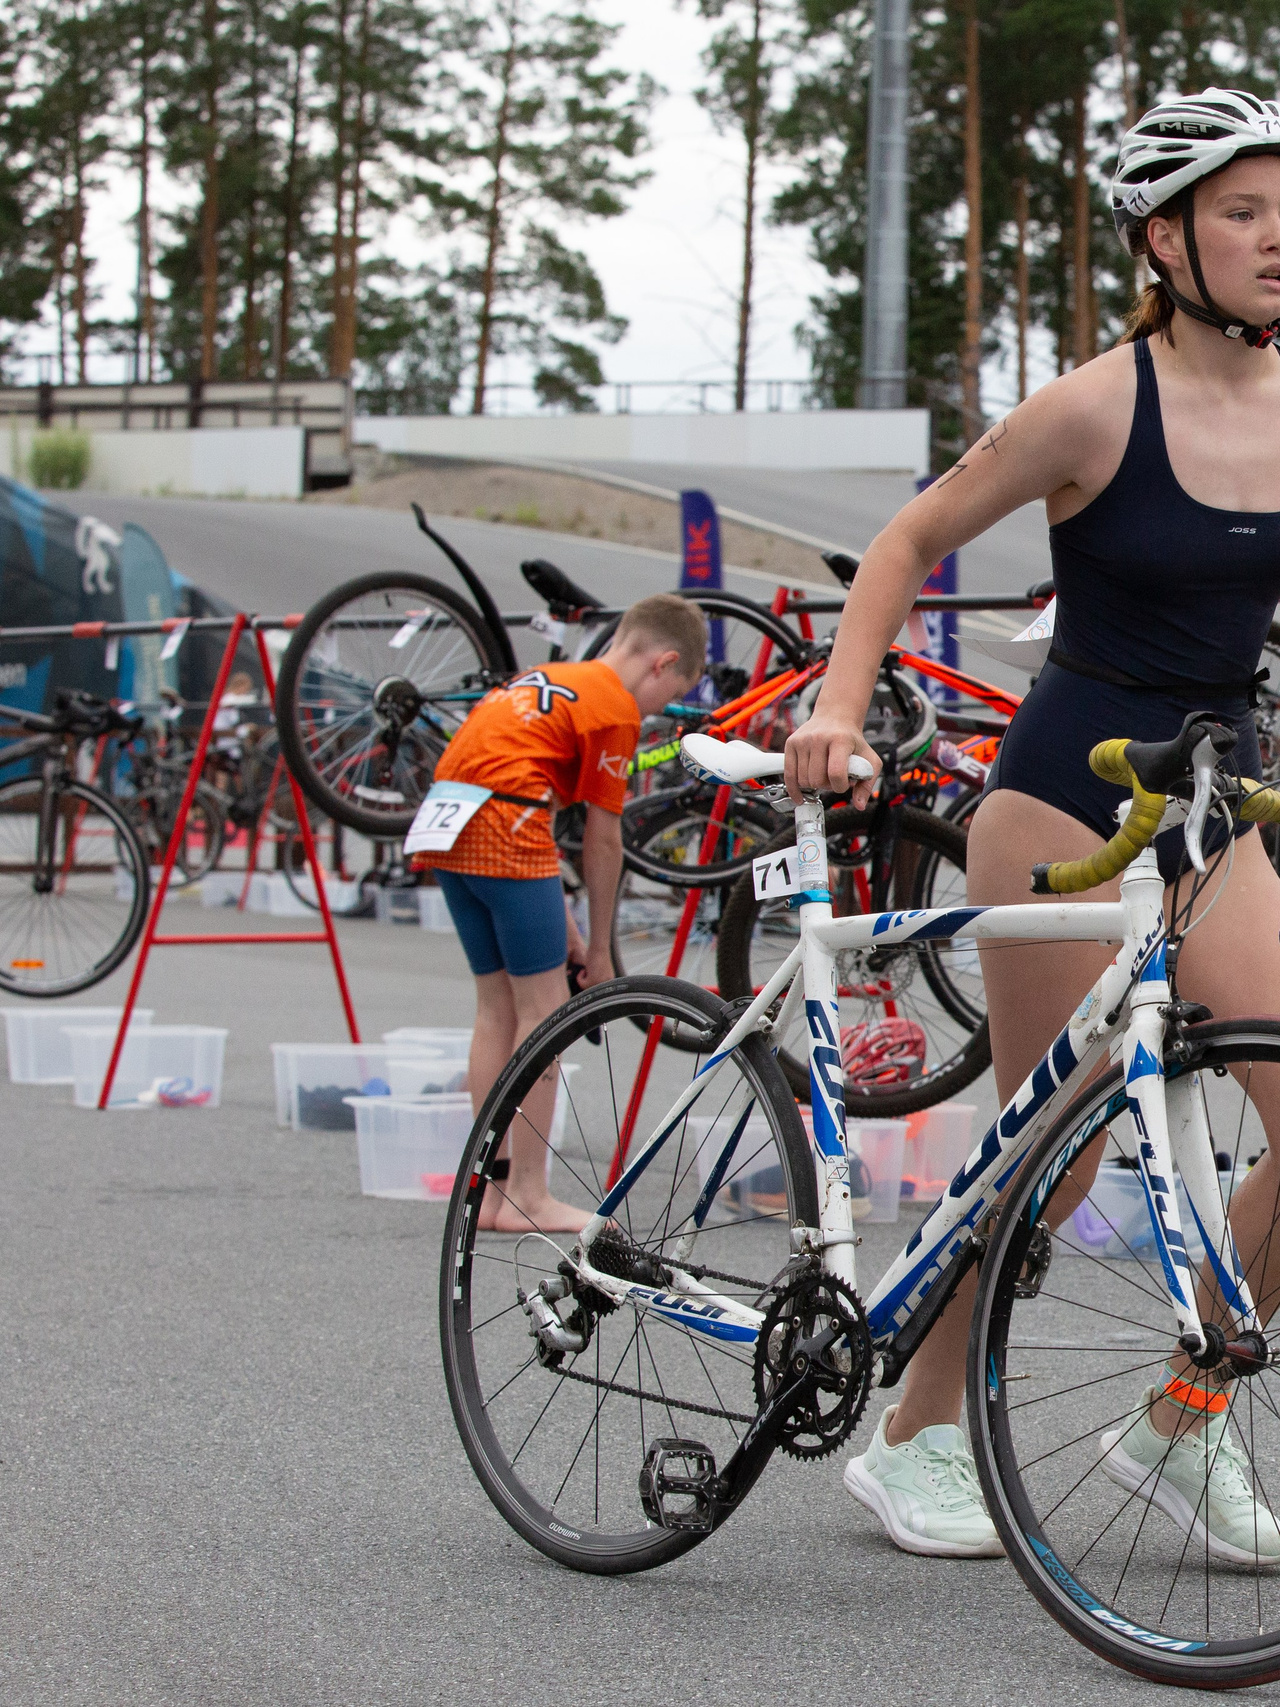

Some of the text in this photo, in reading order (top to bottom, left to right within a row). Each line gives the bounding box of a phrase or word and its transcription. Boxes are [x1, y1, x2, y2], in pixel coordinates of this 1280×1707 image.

[1158, 121, 1214, 136] MET
[1129, 190, 1151, 214] 71
[1228, 526, 1257, 535] JOSS
[425, 801, 461, 830] 72
[754, 857, 792, 892] 71
[1036, 1102, 1109, 1206] VERA
[626, 1286, 727, 1319] FUJI
[547, 1521, 582, 1540] SHIMANO
[1041, 1551, 1193, 1651] VERA CORSA
